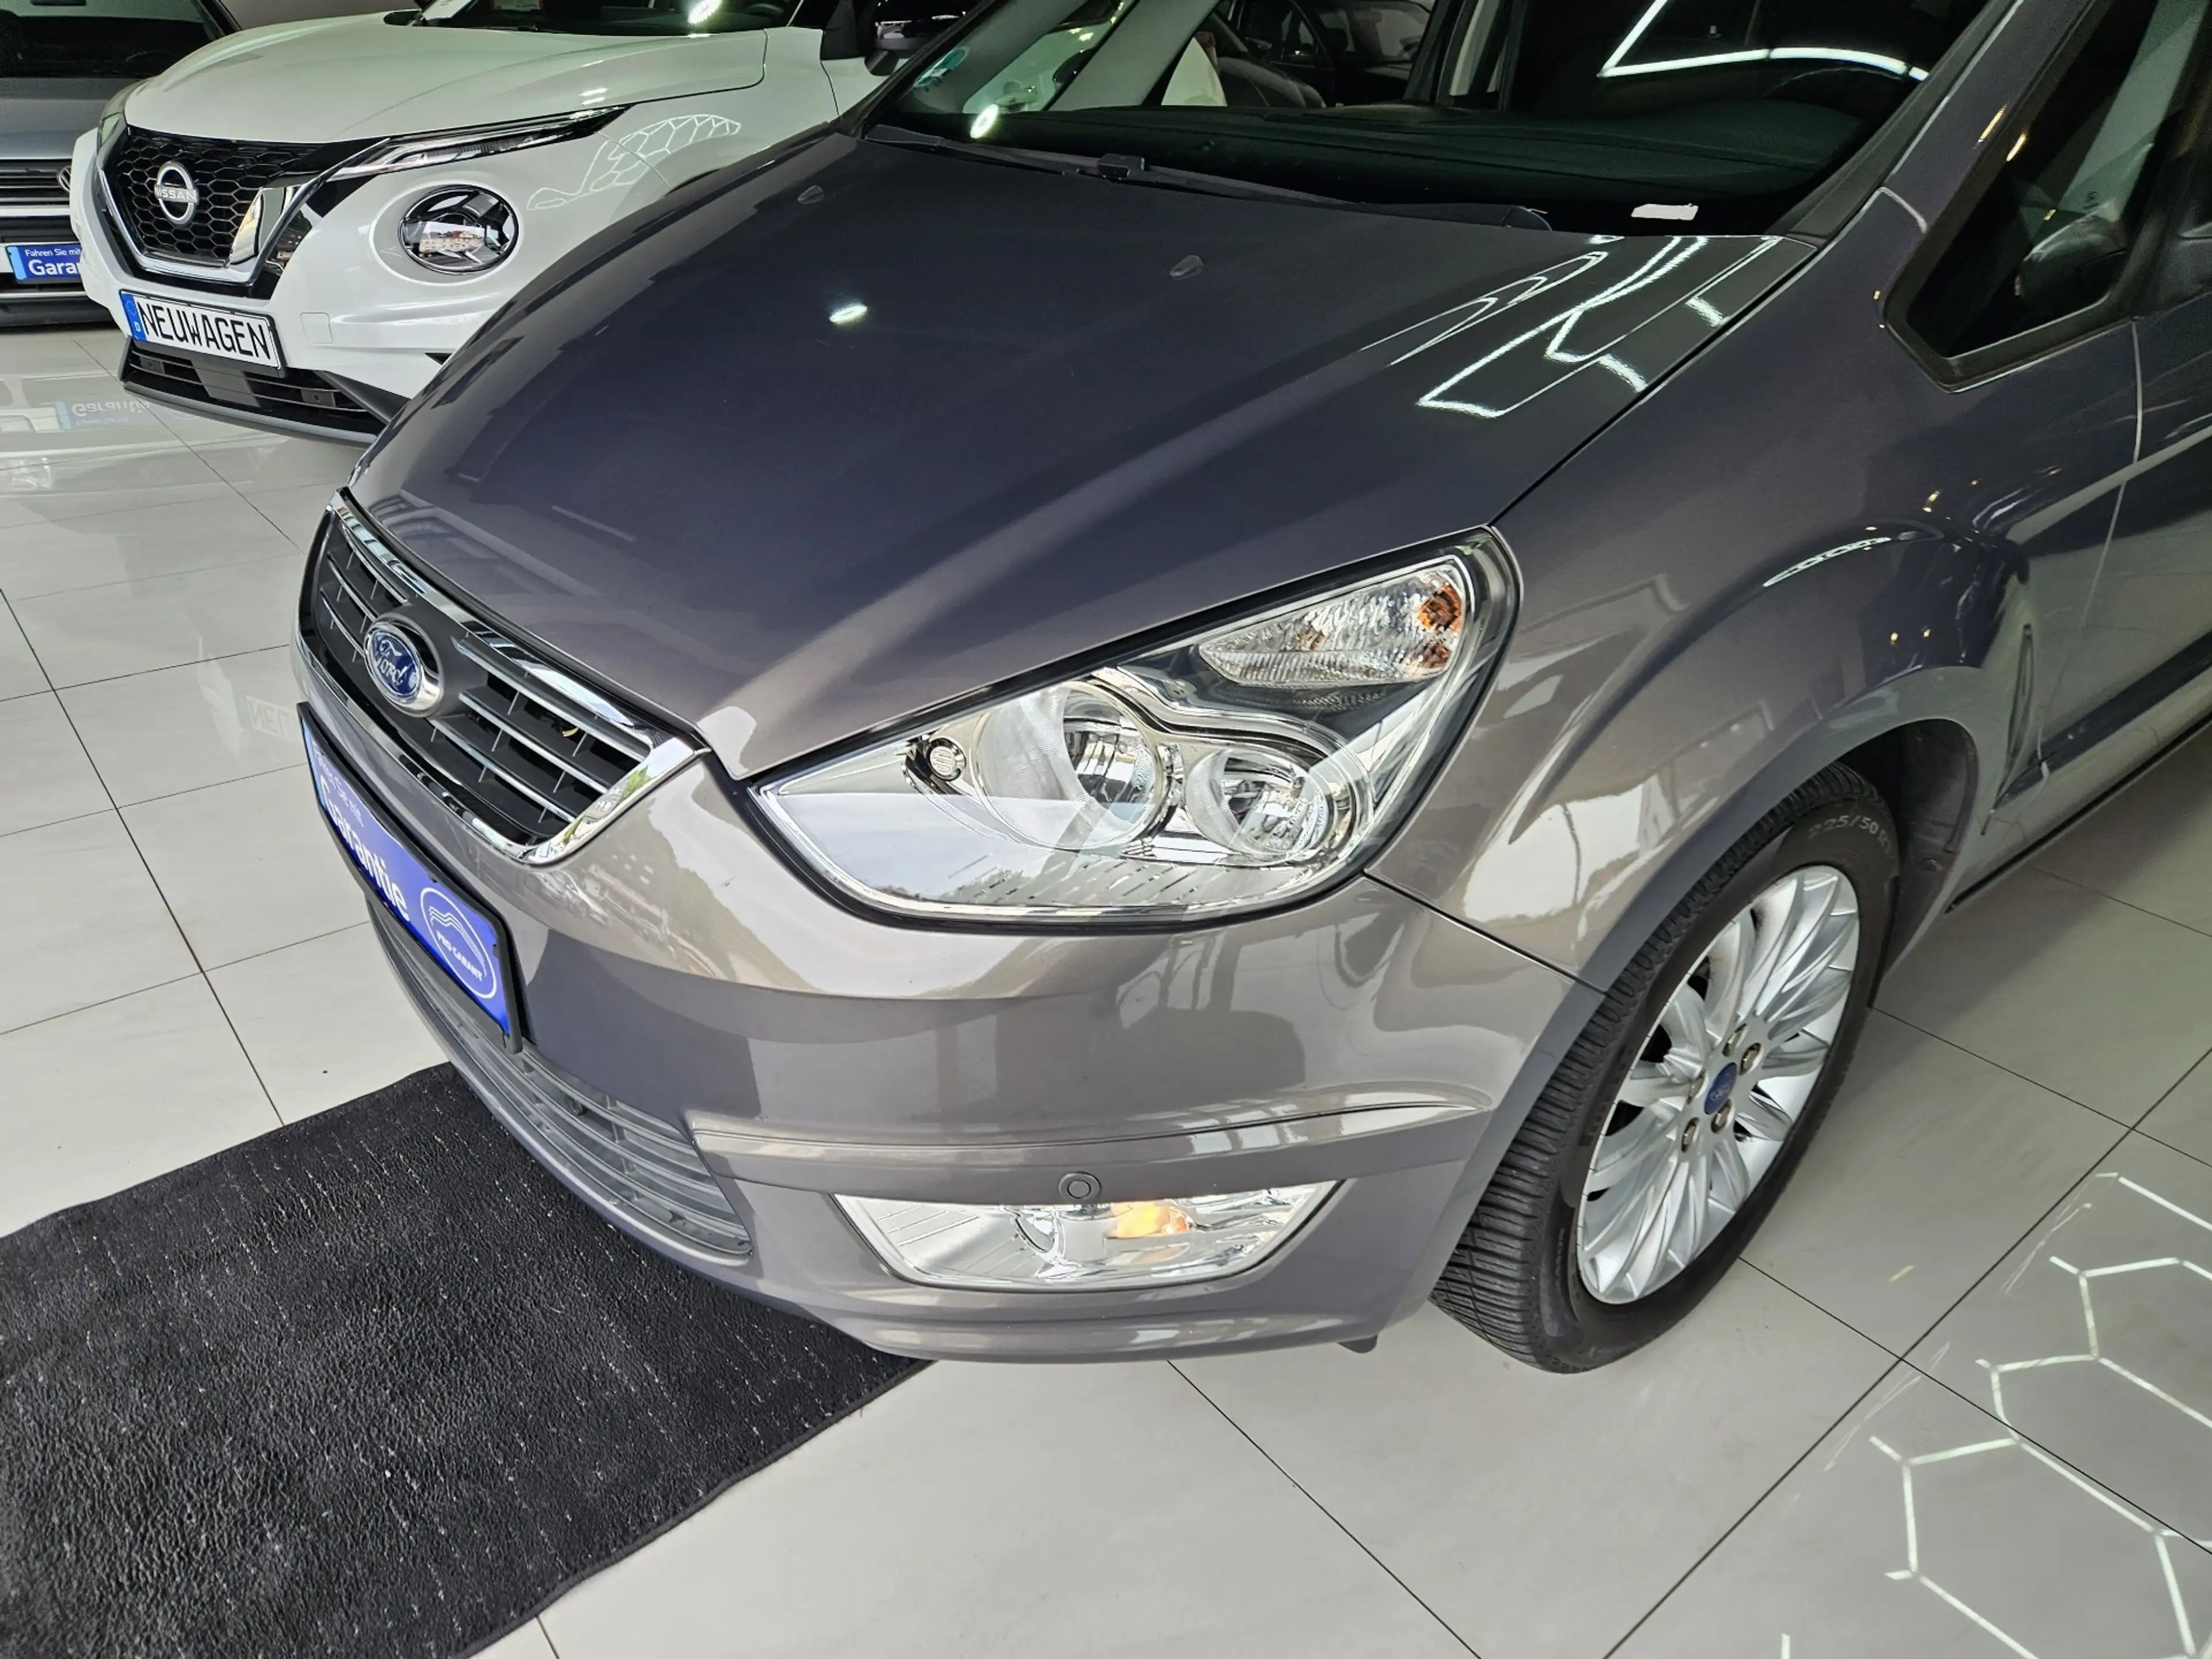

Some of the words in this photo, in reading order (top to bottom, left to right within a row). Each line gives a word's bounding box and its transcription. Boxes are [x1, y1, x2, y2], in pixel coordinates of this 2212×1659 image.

[154, 186, 197, 202] NISSAN
[25, 248, 54, 257] Fahren
[137, 301, 271, 359] NEUWAGEN
[374, 639, 414, 686] Ford
[320, 773, 410, 922] Garantie
